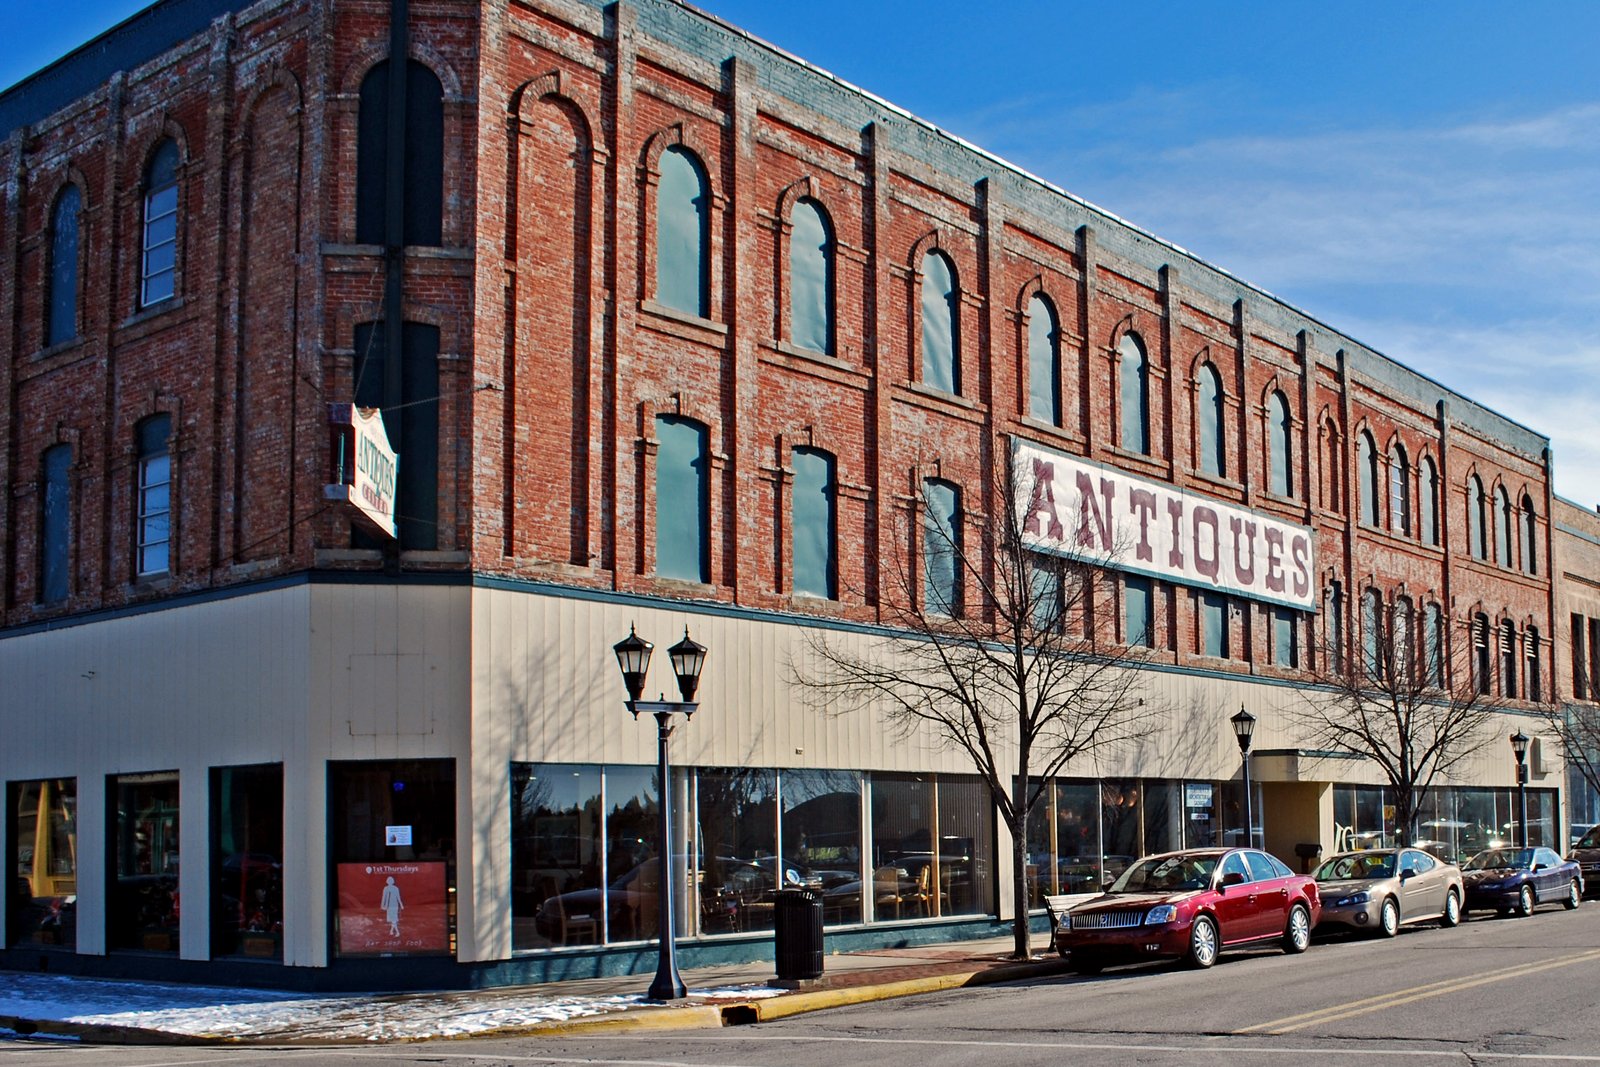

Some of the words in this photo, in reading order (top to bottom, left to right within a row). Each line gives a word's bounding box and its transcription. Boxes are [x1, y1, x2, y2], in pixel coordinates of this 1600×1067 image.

[357, 430, 395, 500] ANTIQUES
[1023, 457, 1310, 599] ANTIQUES
[372, 865, 383, 873] 1st
[383, 864, 419, 874] Thursdays
